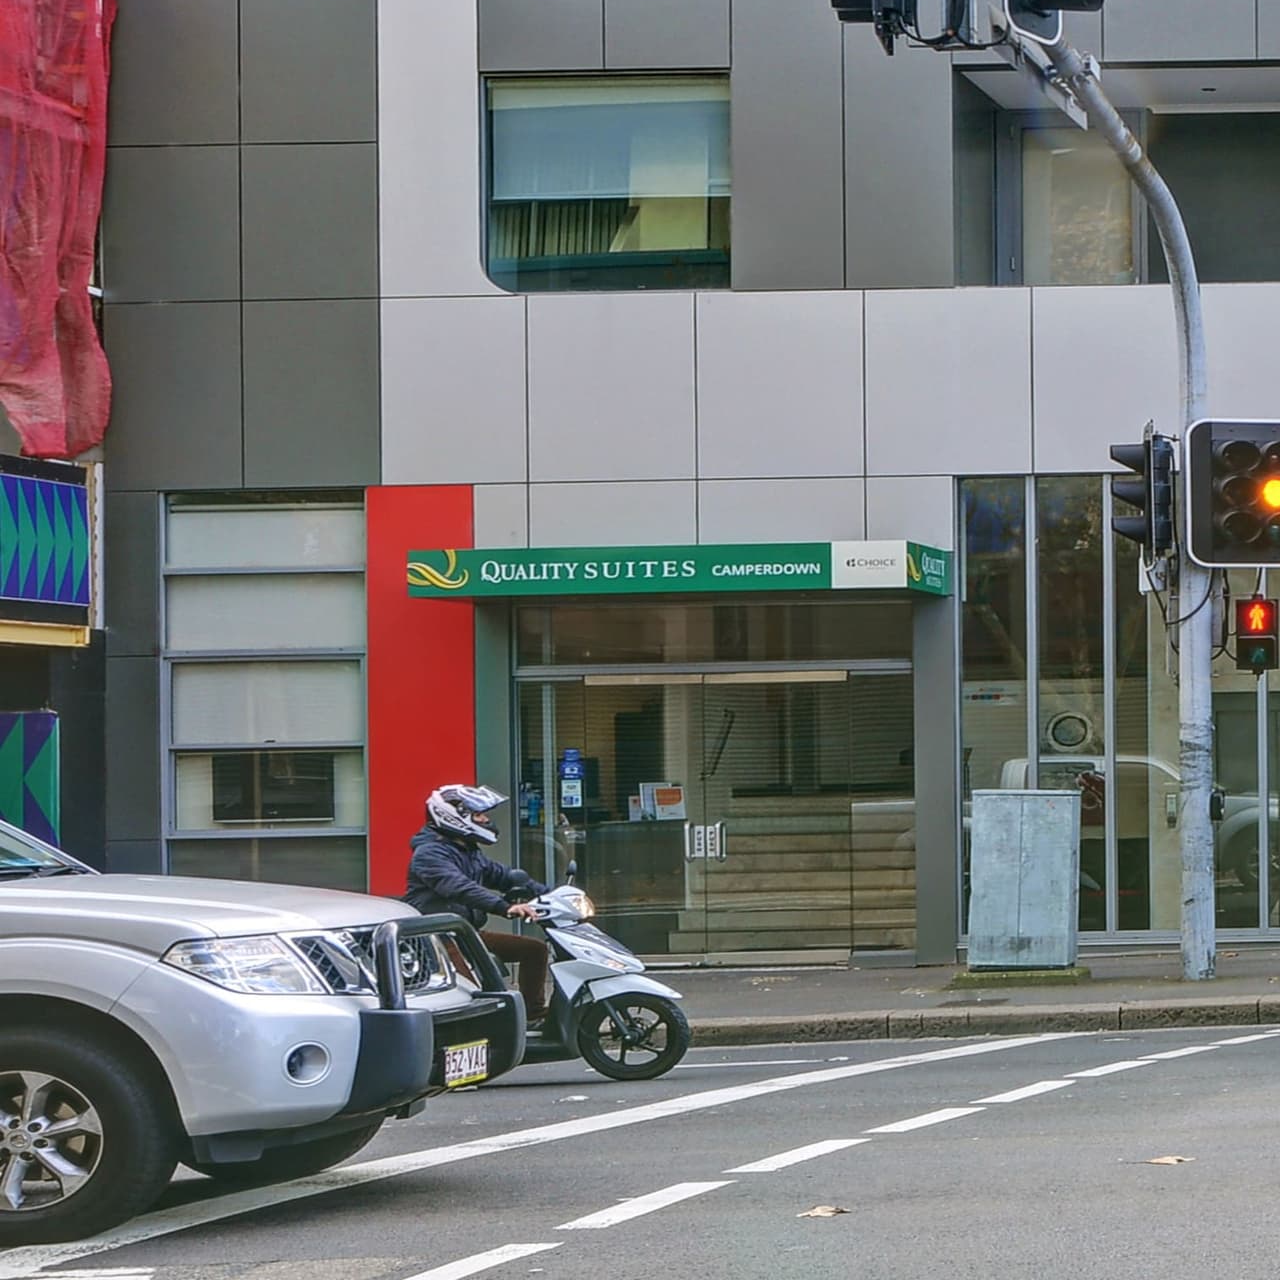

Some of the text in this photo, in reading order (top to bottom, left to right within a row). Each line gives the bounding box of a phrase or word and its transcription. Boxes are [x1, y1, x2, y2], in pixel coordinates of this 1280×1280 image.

[857, 558, 897, 568] CHOICE
[481, 560, 821, 584] QUALITY SUITES CAMPERDOWN
